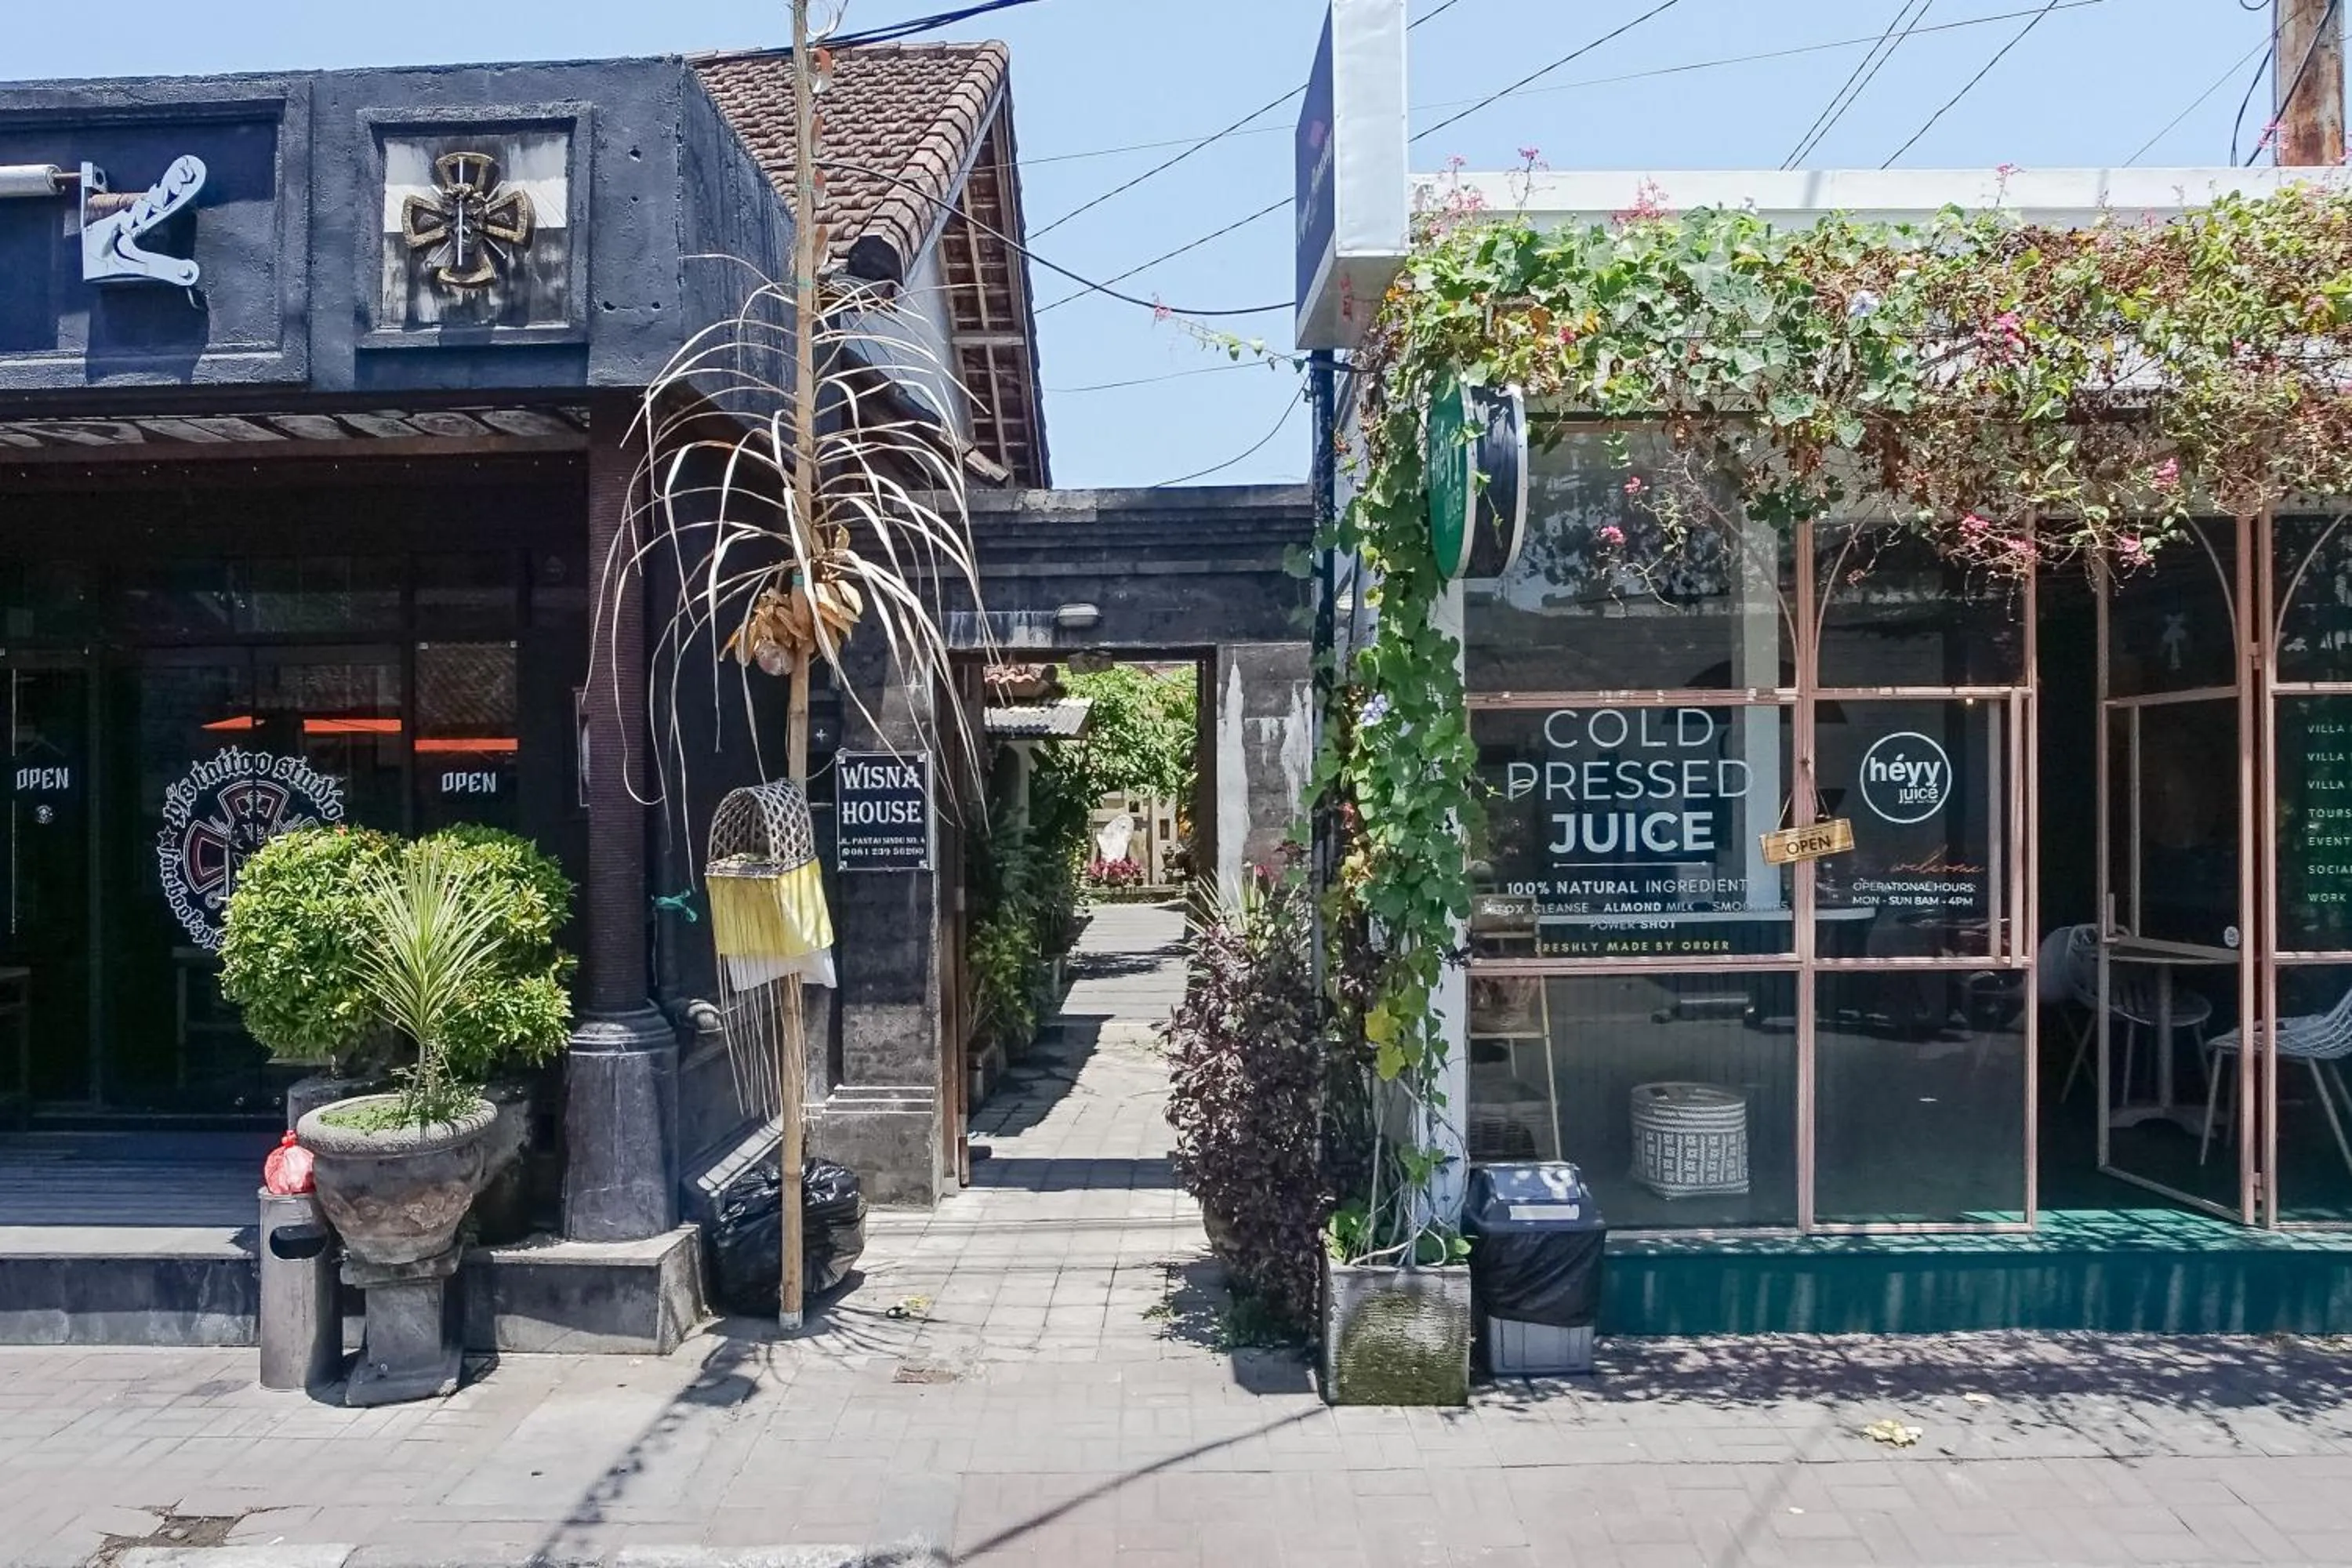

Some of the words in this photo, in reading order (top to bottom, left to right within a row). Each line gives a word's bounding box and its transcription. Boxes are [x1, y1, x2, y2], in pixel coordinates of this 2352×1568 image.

[1544, 708, 1715, 749] COLD
[2307, 724, 2345, 734] VILLA
[2307, 753, 2345, 761] VILLA
[840, 761, 920, 789] WISNA
[1869, 753, 1942, 788] héyy
[16, 767, 69, 790] OPEN
[190, 746, 273, 790] tattoo
[273, 756, 344, 821] studio
[441, 771, 497, 793] OPEN
[1506, 760, 1754, 801] PRESSED
[2307, 781, 2345, 789] VILLA
[841, 800, 924, 824] HOUSE
[2307, 808, 2352, 818] TOURS
[1548, 811, 1715, 854] JUICE
[1787, 835, 1831, 855] OPEN
[1506, 881, 1551, 895] 100%
[1556, 880, 1639, 895] NATURAL
[1853, 881, 1932, 892] OPERATIONAL
[1852, 895, 1879, 905] MON
[1889, 896, 1912, 906] SUN
[1948, 896, 1973, 906] 4PM
[2307, 893, 2347, 902] WORK
[1532, 902, 1589, 914] CLEANSE
[1603, 902, 1661, 913] ALMOND
[1666, 901, 1694, 912] MILK
[1639, 919, 1676, 929] SHOT
[1606, 941, 1649, 952] MADE
[1655, 941, 1674, 951] BY
[1681, 940, 1730, 951] ORDER
